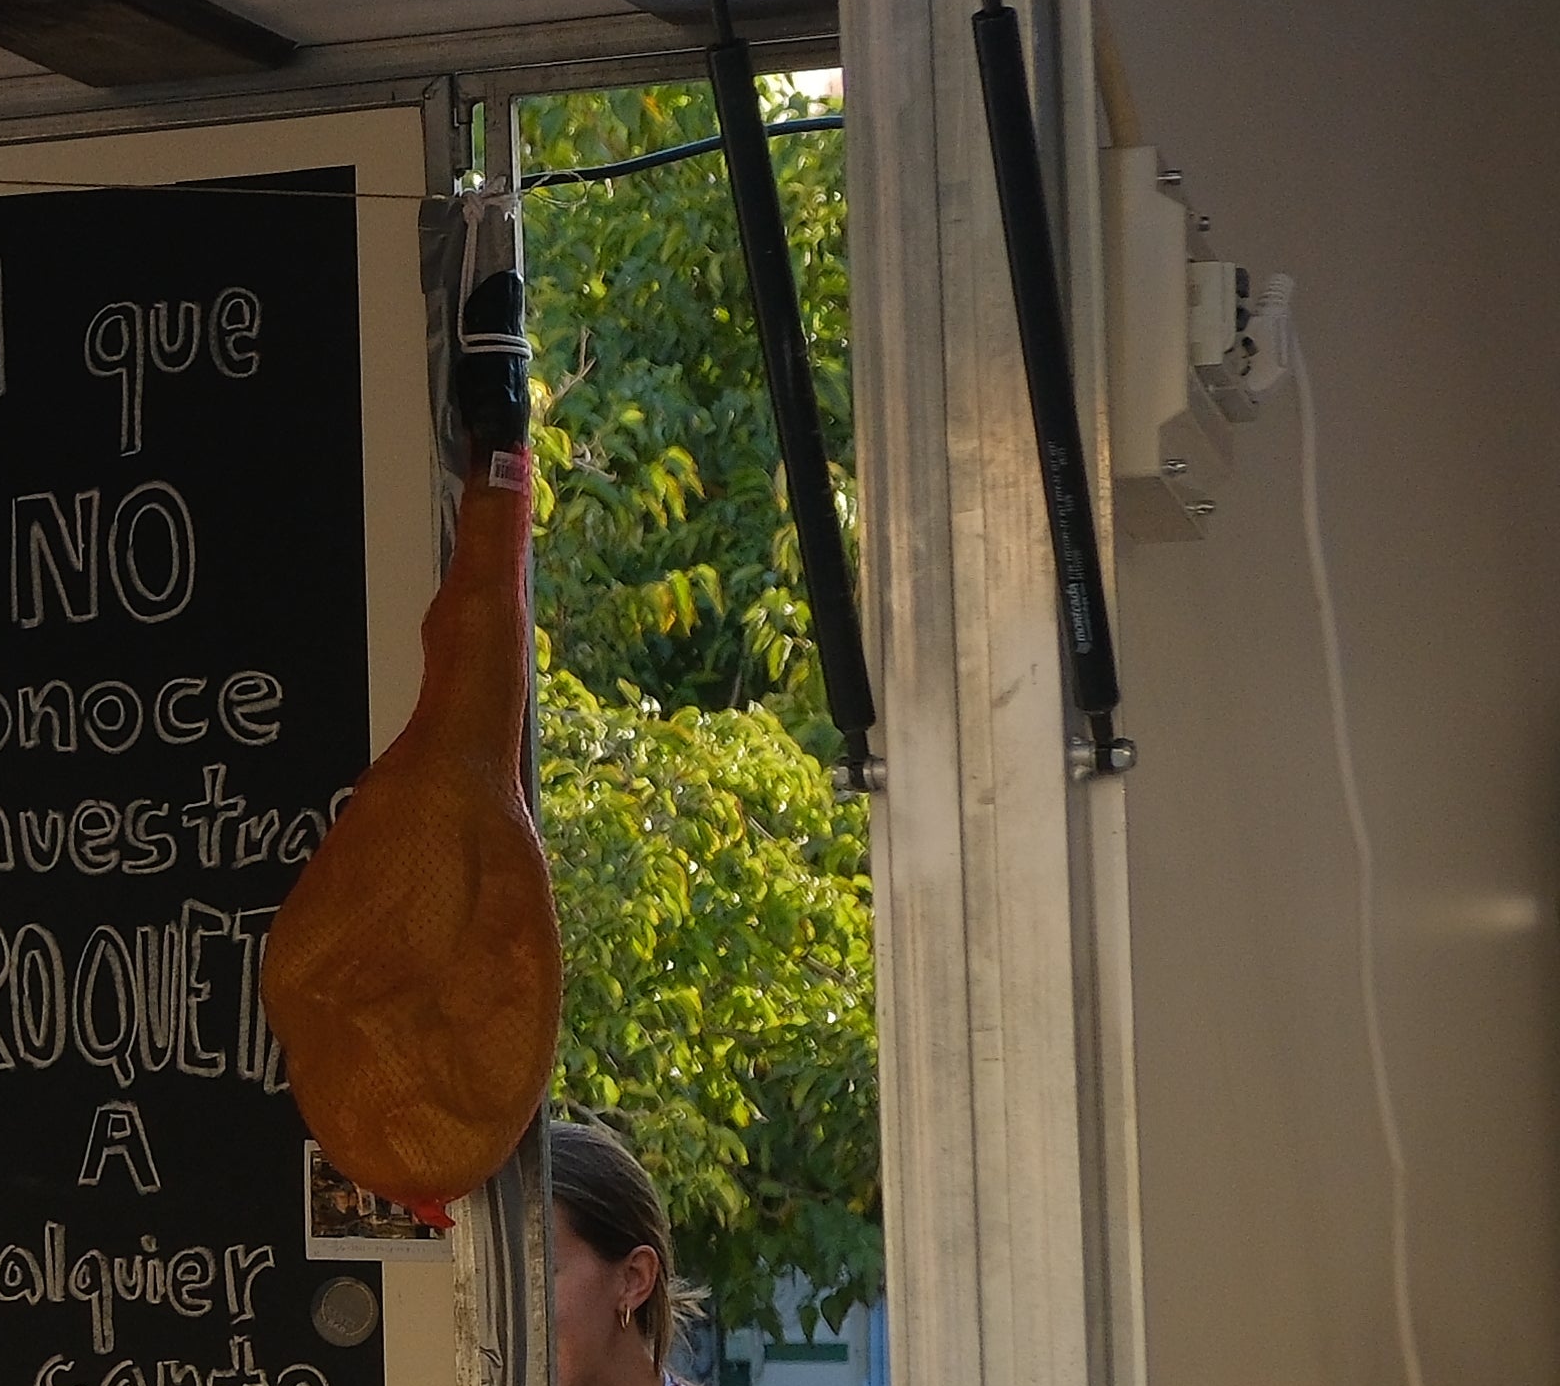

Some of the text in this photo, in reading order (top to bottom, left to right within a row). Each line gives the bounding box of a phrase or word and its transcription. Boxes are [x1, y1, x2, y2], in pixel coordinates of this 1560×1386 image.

[85, 286, 261, 456] que
[11, 480, 195, 629] NO
[78, 1102, 160, 1193] A
